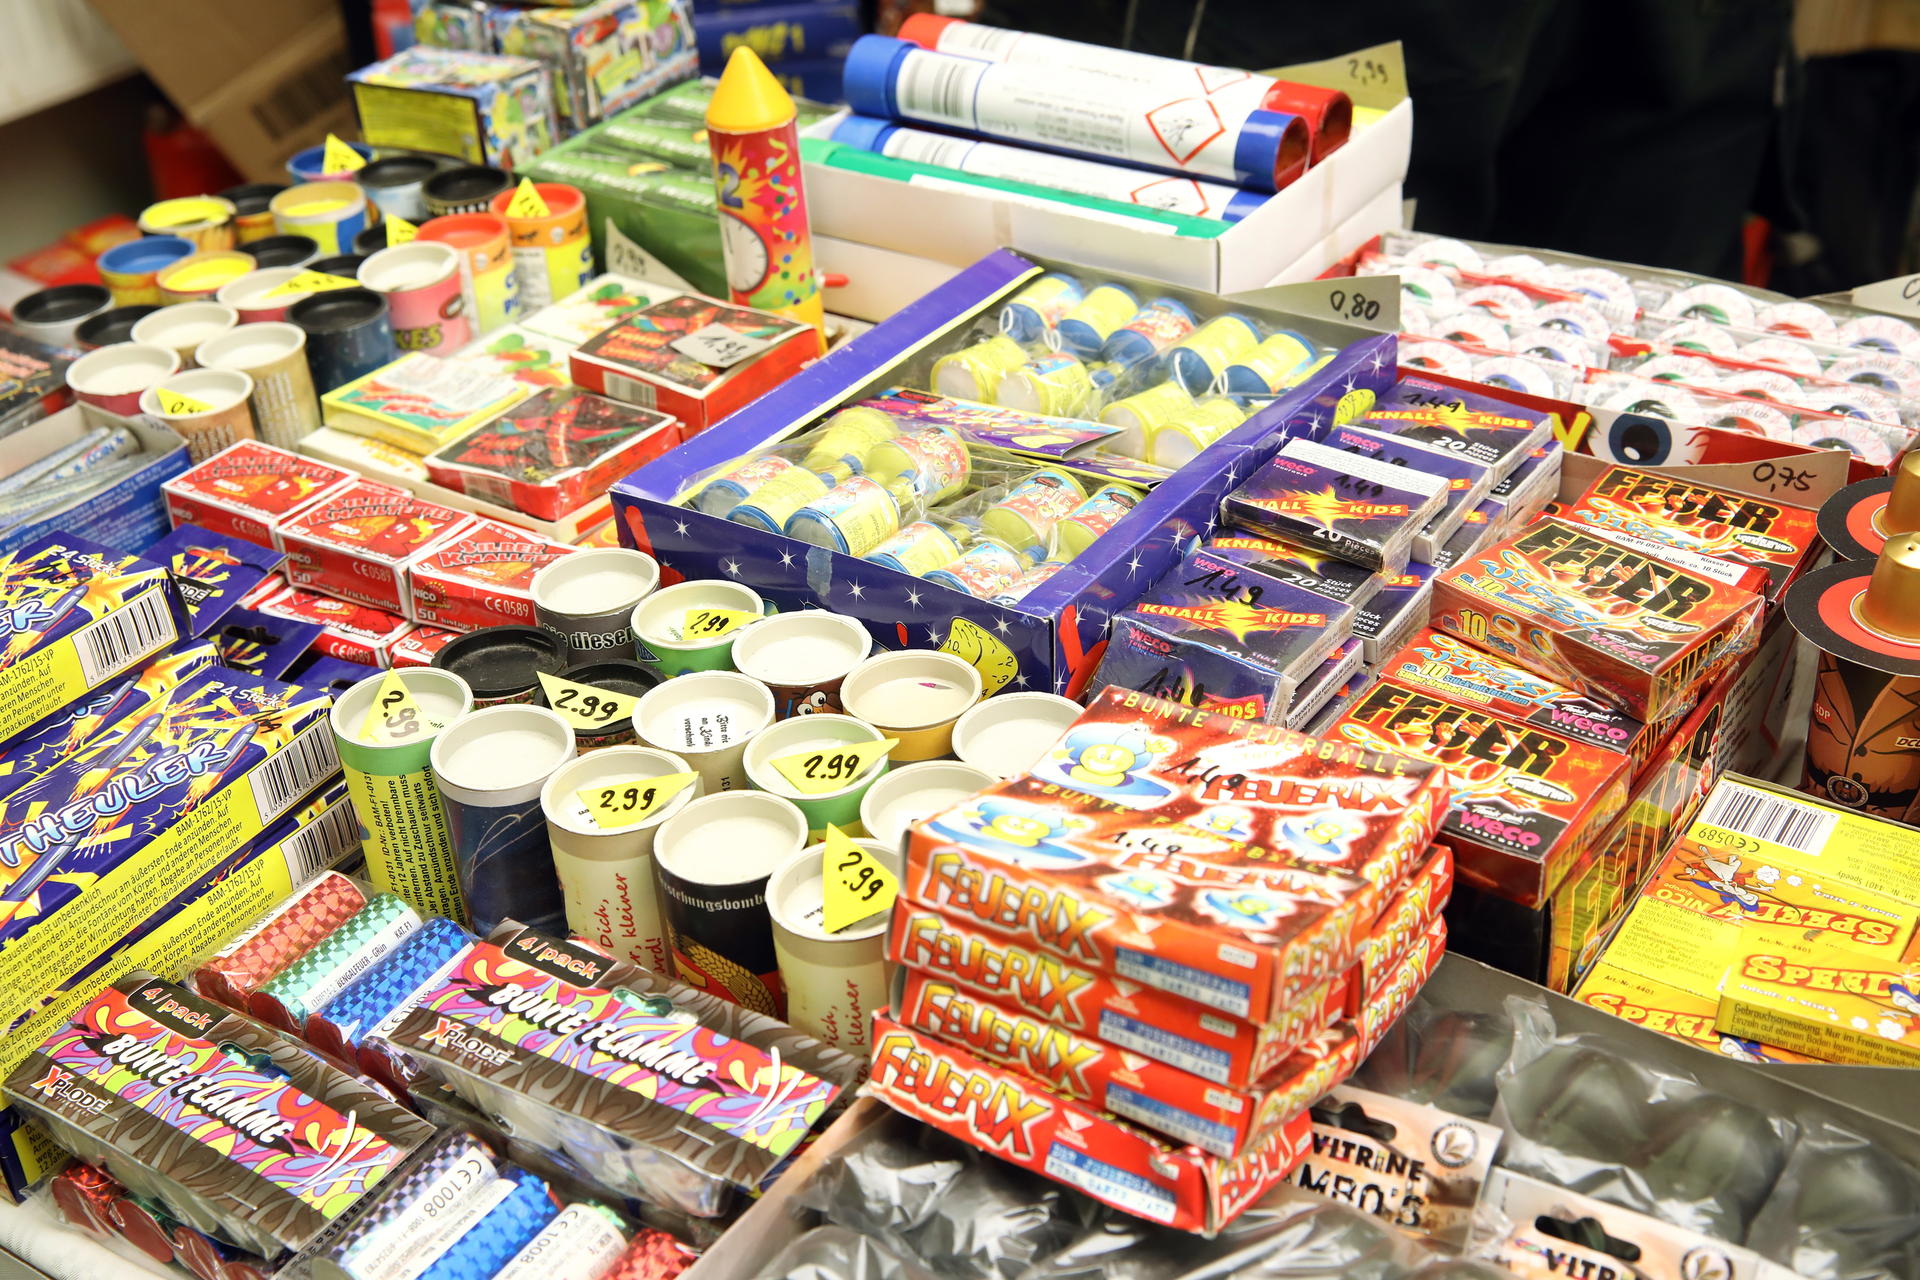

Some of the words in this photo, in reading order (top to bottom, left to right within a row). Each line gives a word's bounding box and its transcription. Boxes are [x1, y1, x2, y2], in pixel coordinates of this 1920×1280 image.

[1330, 290, 1381, 320] 0,80
[1368, 410, 1436, 422] KNALL
[1478, 415, 1530, 429] KIDS
[1431, 435, 1466, 451] 20
[1753, 461, 1817, 492] 0,75
[1349, 504, 1402, 515] KIDS
[1594, 466, 1783, 534] FEUER
[458, 540, 546, 555] SILBER
[1282, 573, 1317, 587] 20
[1476, 575, 1508, 595] 10
[1511, 523, 1715, 621] FEUER
[413, 588, 437, 602] NICO
[417, 608, 437, 621] 50
[1141, 604, 1217, 621] KNALL
[1263, 612, 1323, 626] KIDS
[1458, 608, 1488, 639] 10
[1589, 631, 1660, 666] weco
[39, 664, 51, 678] Auf
[1419, 660, 1451, 679] 10
[12, 695, 46, 718] Personen
[47, 682, 65, 698] unter
[17, 678, 54, 703] Menschen
[205, 680, 239, 696] 24
[234, 688, 285, 708] Stück
[553, 688, 619, 722] 2.99
[381, 689, 421, 738] 2.99
[1349, 682, 1570, 778] FEUER
[1550, 707, 1628, 740] weco
[1123, 692, 1213, 728] BUNTE
[1228, 718, 1413, 777] FEUERBÄLLE
[803, 753, 860, 780] 2.99
[388, 781, 404, 825] brennbare
[399, 774, 410, 798] muss
[414, 783, 428, 821] seitwärts
[428, 793, 439, 811] sich
[600, 786, 656, 813] 2.99
[176, 789, 231, 836] BAM-1762/15-VP
[380, 798, 396, 841] verboten!
[405, 800, 423, 851] Zuschauern
[432, 813, 443, 830] und
[1458, 809, 1542, 847] weco
[398, 826, 410, 846] nicht
[423, 821, 443, 885] Anzündschnur
[438, 830, 453, 872] anzünden
[392, 843, 404, 871] Jahren
[403, 849, 414, 863] Auf
[418, 852, 426, 861] zu
[23, 925, 68, 963] verwenden!
[69, 889, 118, 930] Anzündschnur
[130, 855, 165, 884] äußersten
[165, 842, 182, 858] Ende
[183, 818, 217, 845] anzünden.
[31, 951, 59, 971] halten,
[59, 936, 75, 951] dass
[88, 905, 117, 929] Fontäne
[133, 874, 155, 896] Körper
[171, 843, 198, 867] anderen
[198, 818, 232, 846] Menschen
[207, 859, 264, 905] BAM-1762/15-VP
[419, 864, 434, 897] Abstand
[837, 851, 885, 902] 2.99
[19, 975, 43, 995] Nicht
[41, 950, 74, 979] entgegen
[87, 904, 136, 943] Windrichtung
[135, 887, 159, 907] halten.
[161, 866, 185, 889] Abgabe
[194, 836, 225, 862] Personen
[225, 822, 242, 839] unter
[53, 888, 101, 928] unbedenklich
[226, 905, 256, 930] Personen
[257, 891, 274, 907] unter
[620, 872, 637, 939] kleiner
[923, 852, 1115, 962] FEUERIX
[1655, 887, 1708, 912] NICO
[21, 974, 58, 1006] verboten!
[60, 955, 86, 978] Abgabe
[108, 904, 152, 941] ungeöffneter
[153, 855, 216, 906] Originalverpackung
[216, 837, 241, 859] erlaubt.
[162, 924, 197, 952] äußersten
[197, 911, 215, 927] Ende
[216, 887, 249, 914] anzünden.
[164, 943, 187, 963] Körper
[199, 912, 230, 936] anderen
[231, 888, 264, 915] Menschen
[337, 956, 370, 988] BENGALFEUER
[514, 936, 601, 982] 4/pack
[903, 916, 1096, 1029] FEUERIX
[9, 999, 71, 1045] Zurschaustellen
[82, 955, 132, 994] unbedenklich
[140, 984, 215, 1031] 4/pack
[849, 979, 867, 1046] kleiner
[26, 1027, 52, 1047] Freien
[418, 1018, 516, 1067] XPLODE
[488, 982, 587, 1034] BUNTE
[585, 1021, 717, 1085] FLAMME
[913, 983, 1104, 1098] FEUERIX
[1825, 1028, 1840, 1038] Nur
[30, 1065, 113, 1115] XPLODE
[102, 1033, 192, 1089] BUNTE
[175, 1074, 297, 1144] FLAMME
[875, 1033, 1052, 1158] FEUERIX
